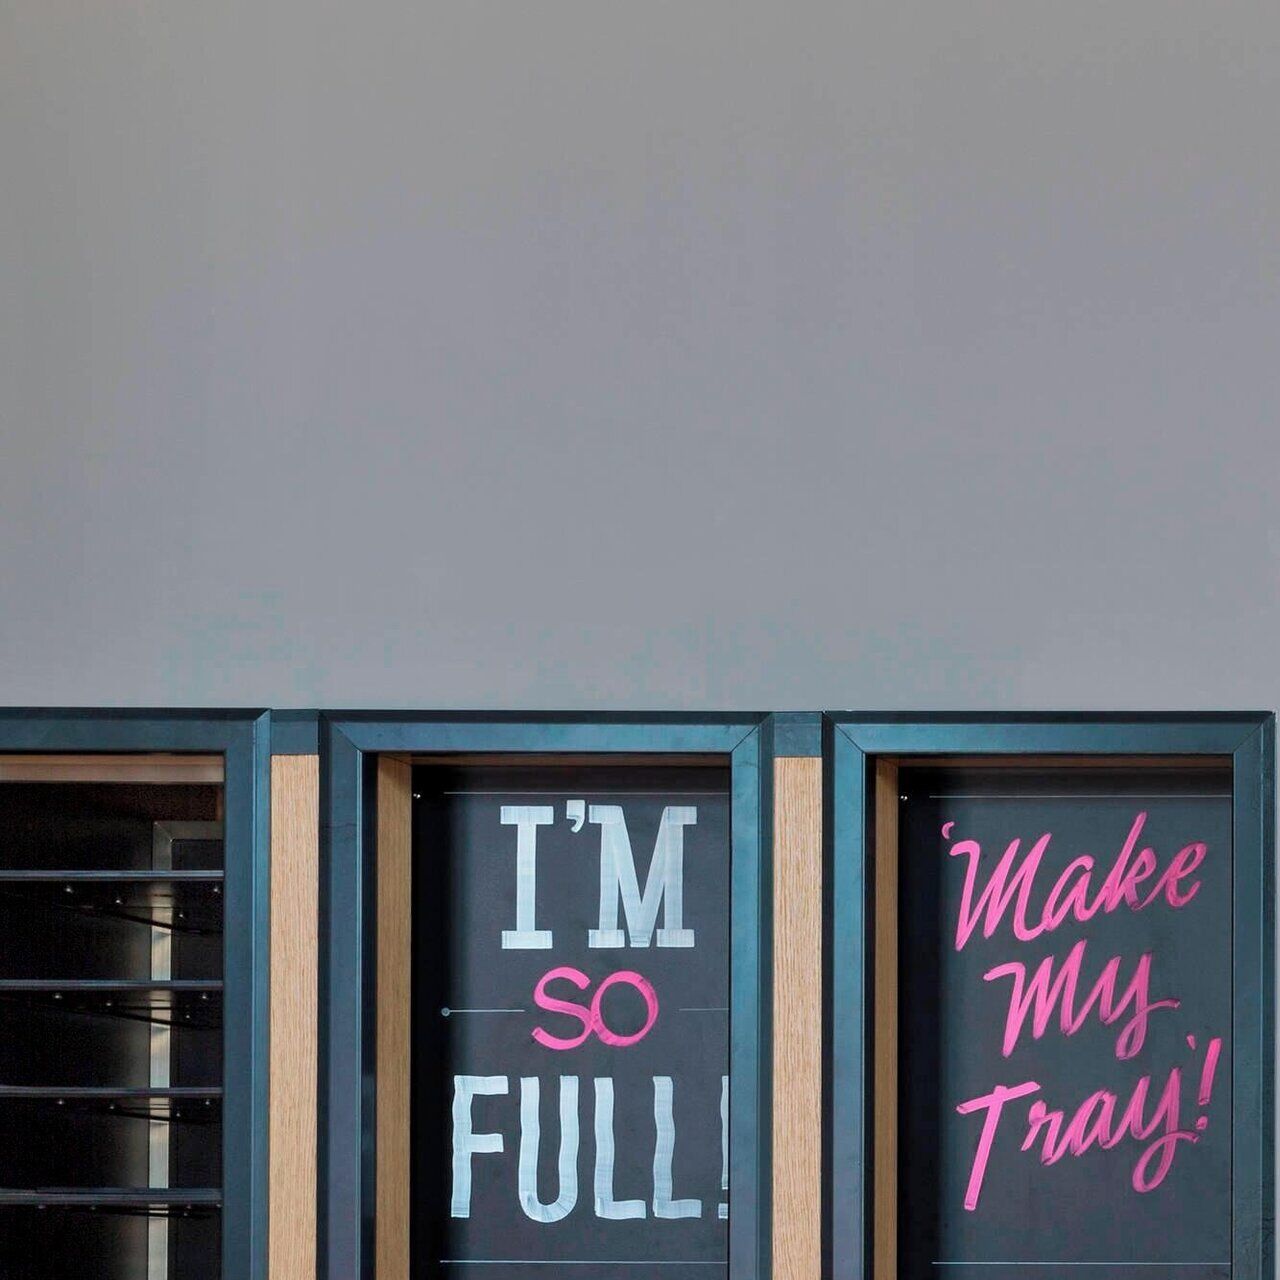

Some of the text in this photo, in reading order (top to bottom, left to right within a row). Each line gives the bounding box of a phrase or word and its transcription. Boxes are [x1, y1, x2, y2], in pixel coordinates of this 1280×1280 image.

[500, 799, 698, 950] I'M
[532, 966, 659, 1050] SO
[984, 939, 1181, 1059] My
